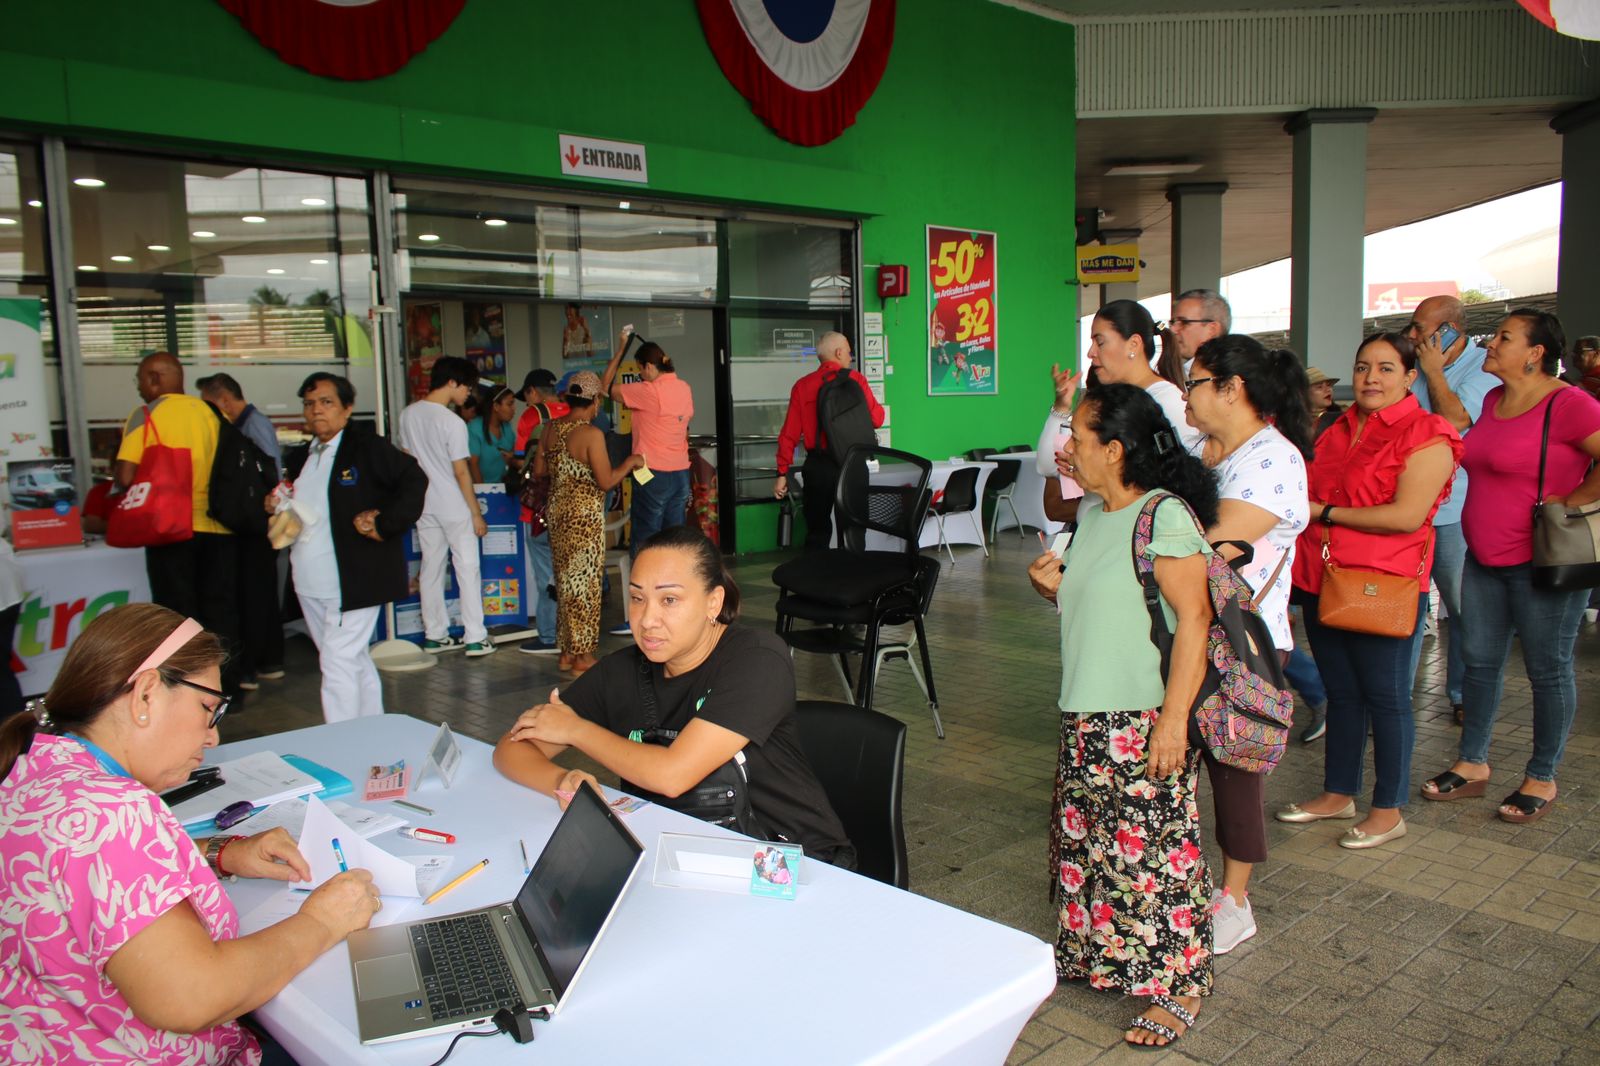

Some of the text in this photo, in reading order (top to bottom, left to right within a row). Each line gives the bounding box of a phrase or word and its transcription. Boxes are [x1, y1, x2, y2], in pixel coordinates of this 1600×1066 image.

[582, 147, 642, 171] ENTRADA
[1101, 258, 1114, 267] ME
[1116, 257, 1134, 266] DAN
[970, 278, 991, 290] Navidad
[955, 298, 990, 341] 3x2
[969, 364, 992, 381] Xtra
[9, 590, 130, 674] tr
